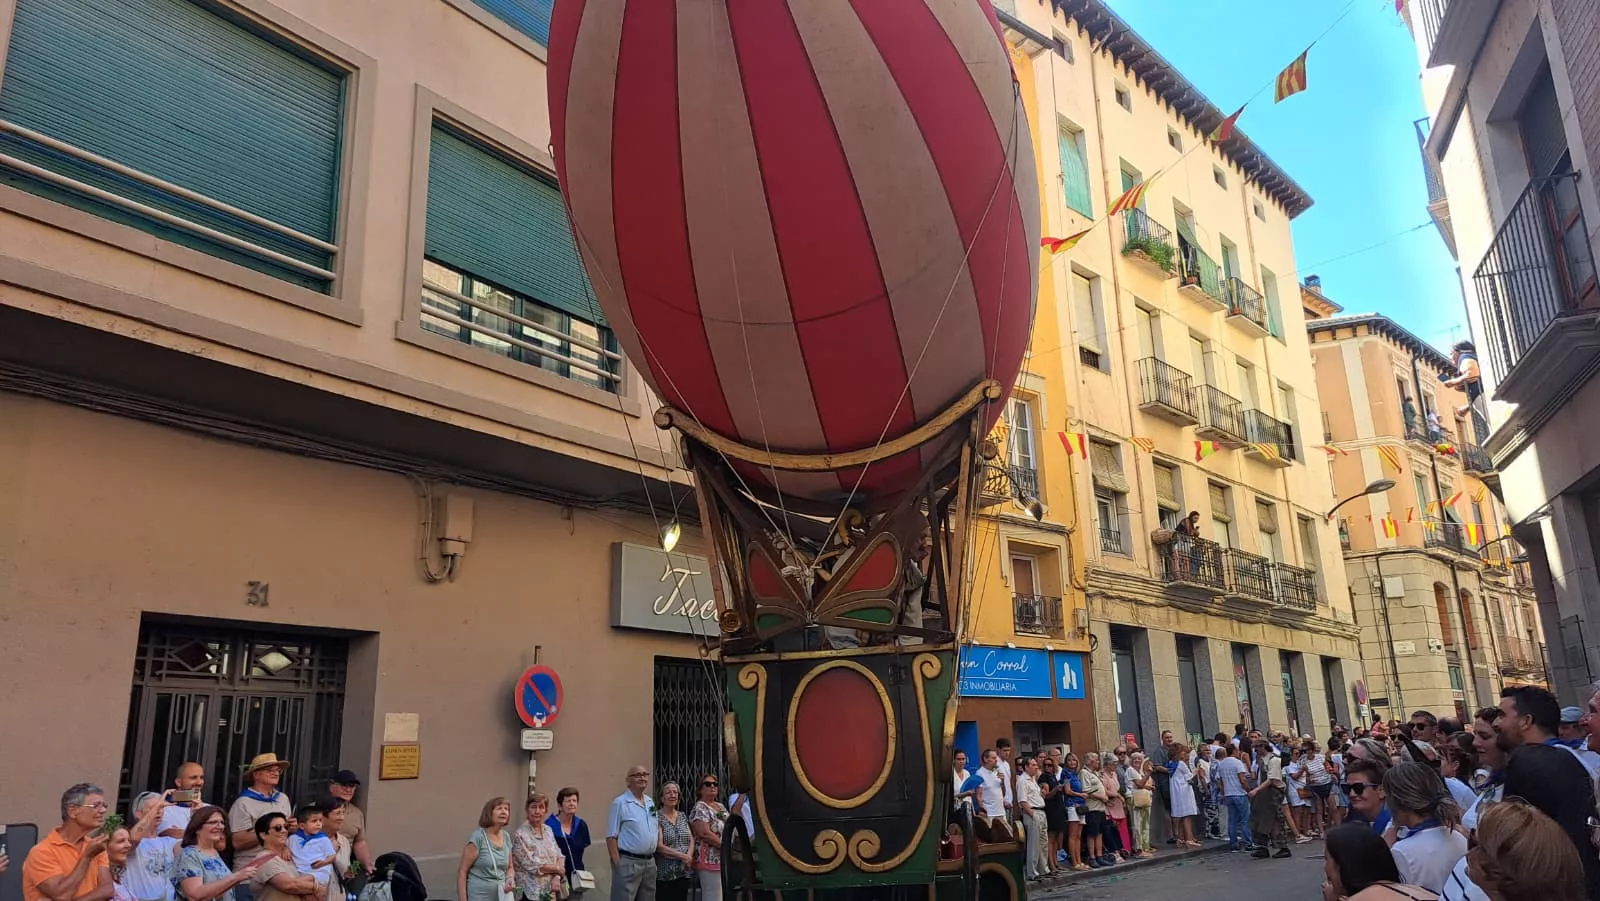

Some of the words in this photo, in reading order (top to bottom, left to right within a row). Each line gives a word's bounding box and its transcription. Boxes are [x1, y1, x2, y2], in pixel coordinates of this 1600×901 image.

[246, 581, 270, 607] 31
[983, 650, 1029, 677] Corral
[969, 681, 1017, 692] INMOBILIARIA
